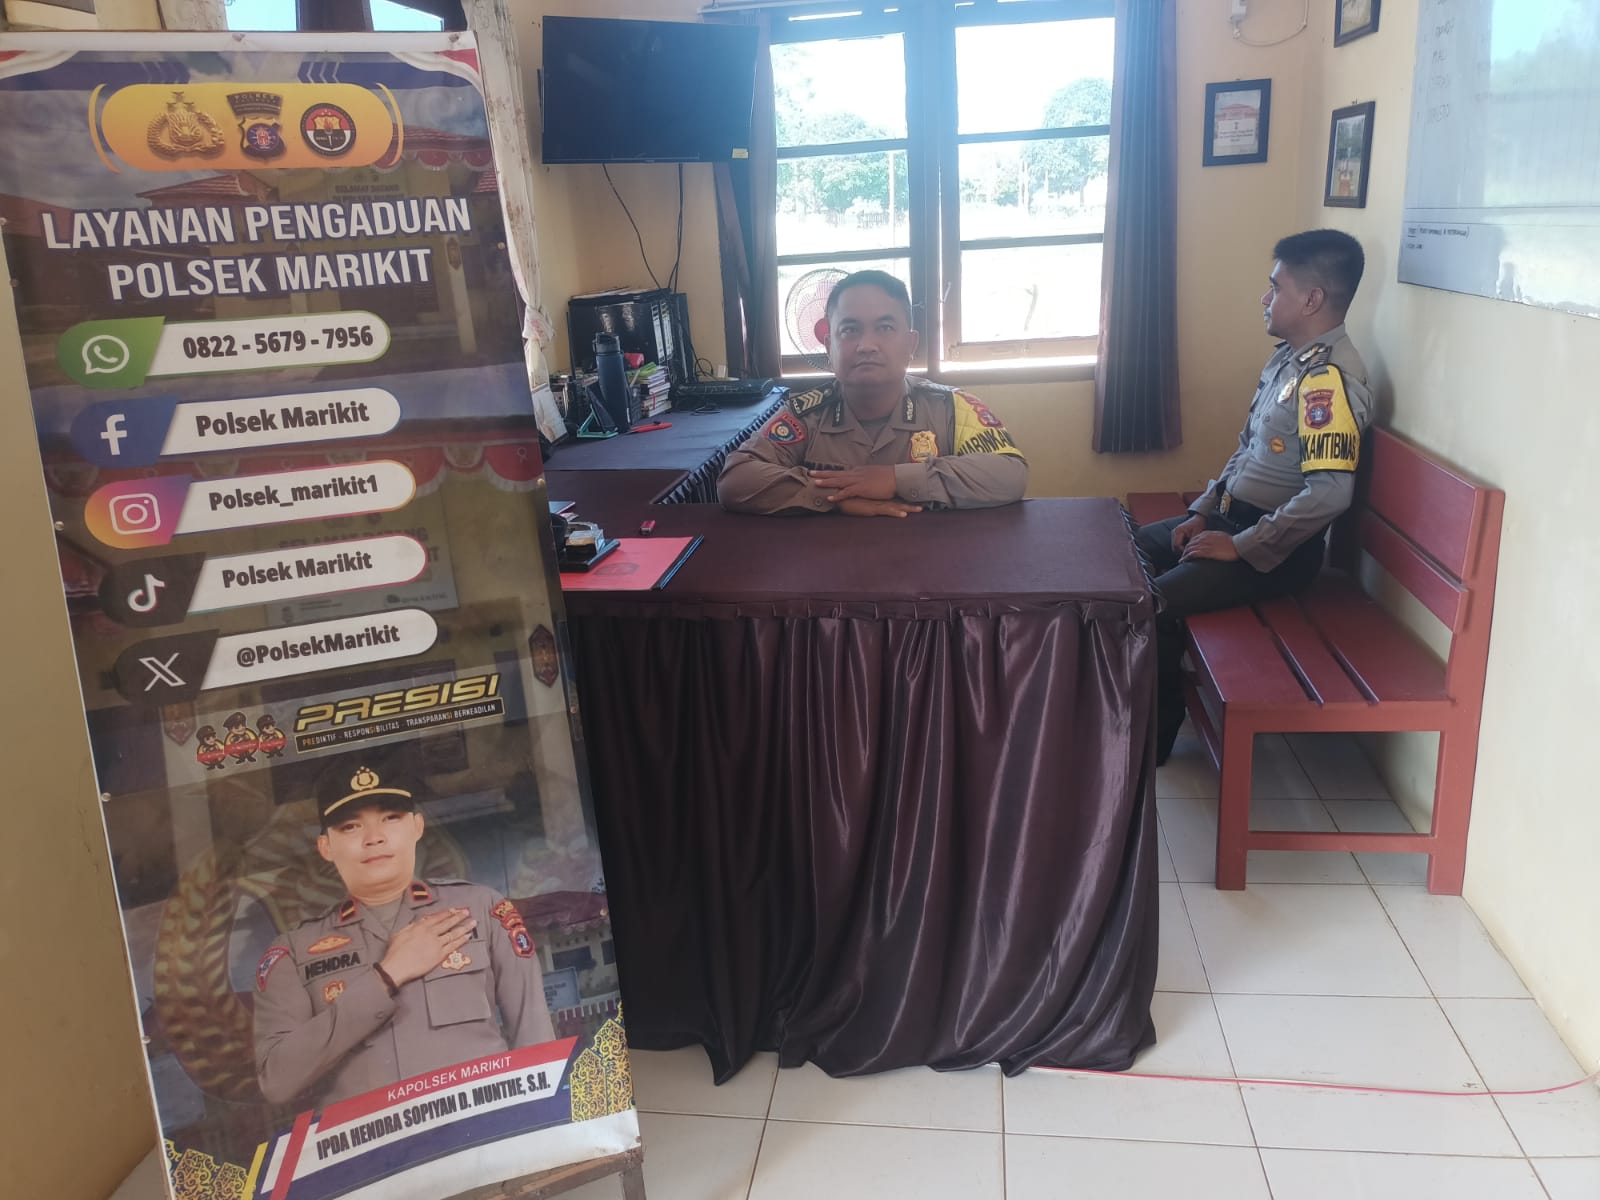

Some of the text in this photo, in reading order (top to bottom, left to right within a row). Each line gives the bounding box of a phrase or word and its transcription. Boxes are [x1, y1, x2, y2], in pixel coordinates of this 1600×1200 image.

[41, 198, 472, 249] LAYANAN PENGADUAN
[108, 248, 431, 300] POLSEK MARIKIT
[182, 335, 238, 359] 0822
[254, 330, 306, 354] 5679
[322, 325, 374, 349] 7956
[195, 401, 370, 437] Polsek Marikit
[209, 474, 379, 511] Polsek_marikit1
[222, 551, 373, 588] Polsek Marikit
[236, 624, 400, 667] @PolsekMarikit
[295, 674, 500, 732] PRESISI
[302, 703, 497, 747] PREDIKTIF RESPONSIBILITAS TRANSPARANSI BERKEADILAN
[305, 951, 361, 980] HENDRA
[387, 1056, 512, 1102] KAPOLSEK MARIKIT
[316, 1071, 551, 1160] IPDA HENDRA SOPIYAN D. MUNTHE, S.H.
